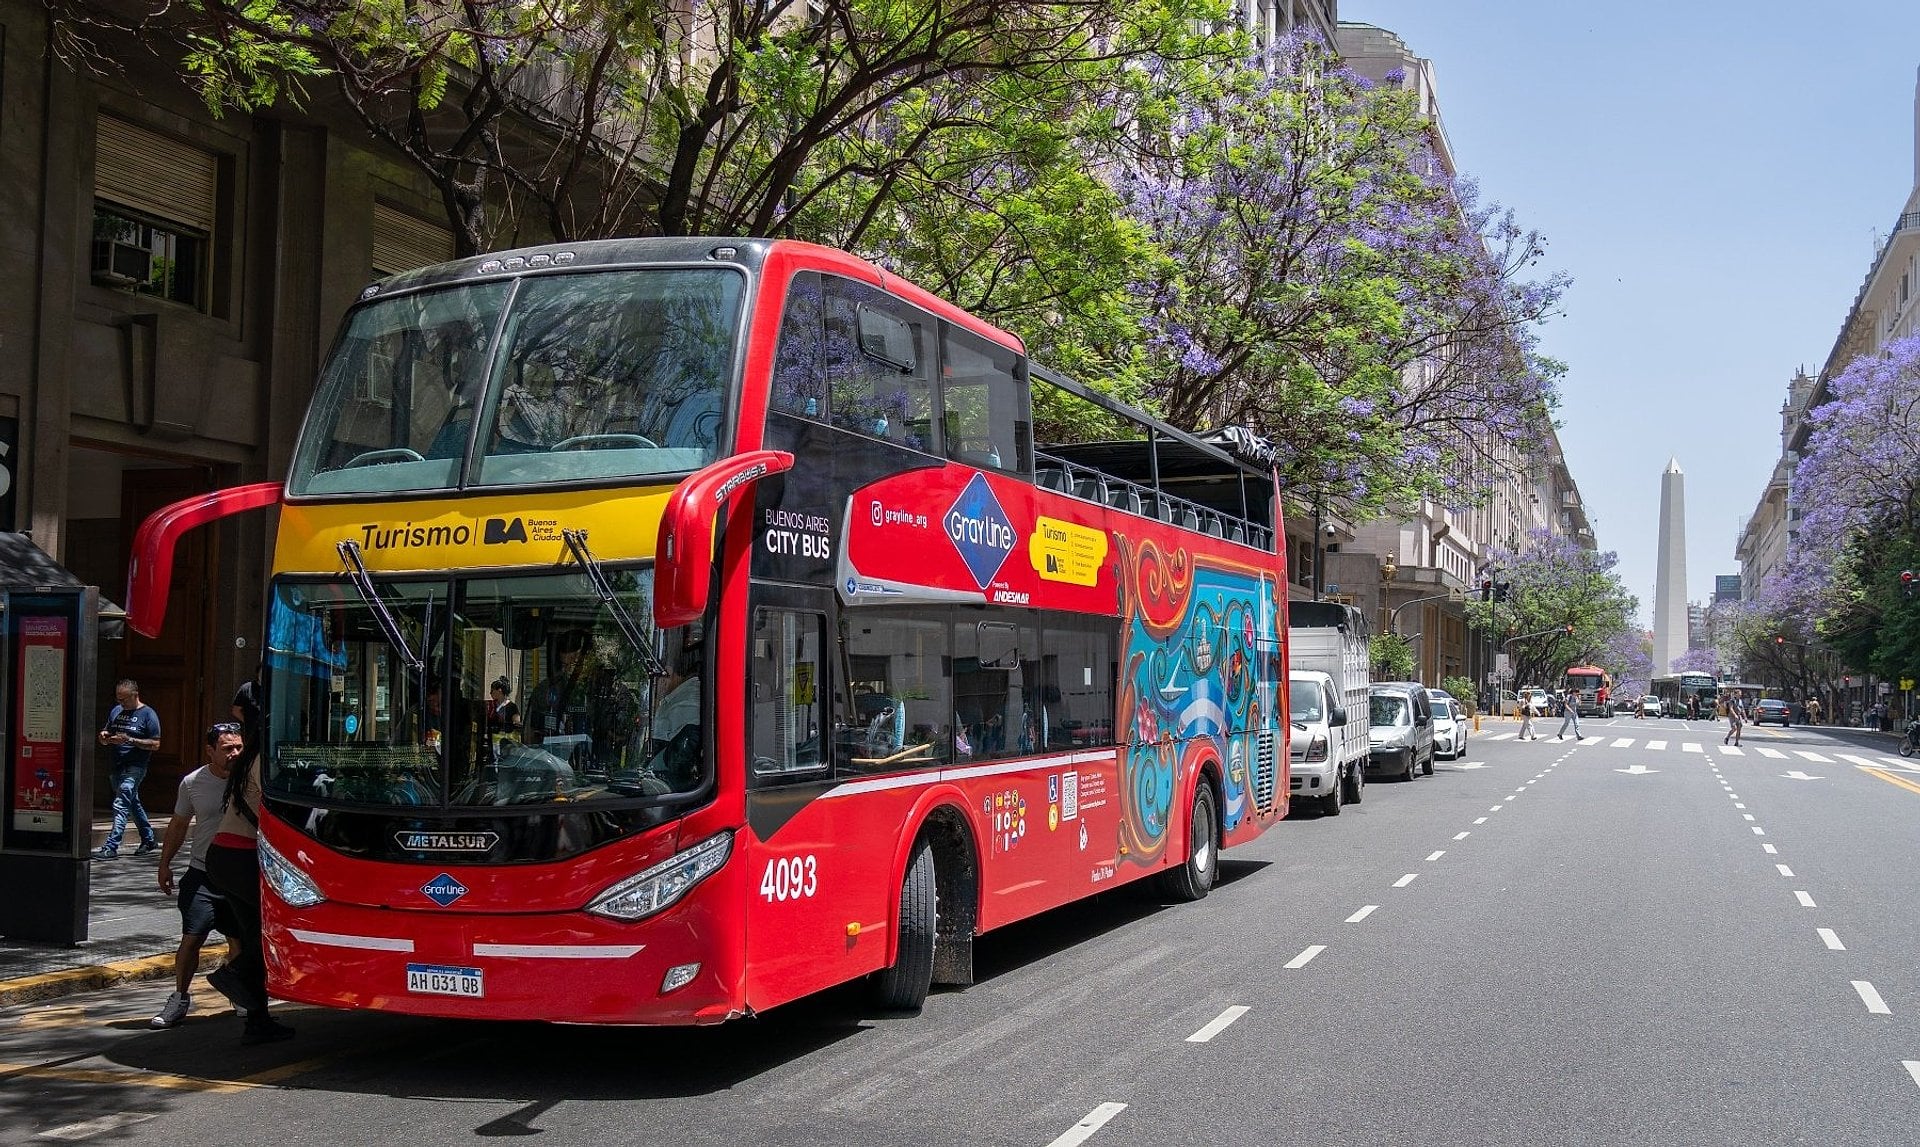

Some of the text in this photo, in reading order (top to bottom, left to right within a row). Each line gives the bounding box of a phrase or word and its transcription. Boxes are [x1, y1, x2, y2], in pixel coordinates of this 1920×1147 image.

[765, 508, 829, 533] BUENOS AIRES
[885, 509, 928, 528] grayline_arg
[361, 517, 527, 550] Turismo BA
[533, 533, 562, 541] Ciudad
[1042, 523, 1067, 542] Turismo
[766, 529, 830, 559] CITY BUS
[993, 590, 1030, 604] ANDESMAR
[406, 835, 486, 848] METALSUR
[760, 855, 817, 902] 4093
[410, 973, 479, 994] AH 031 QB
